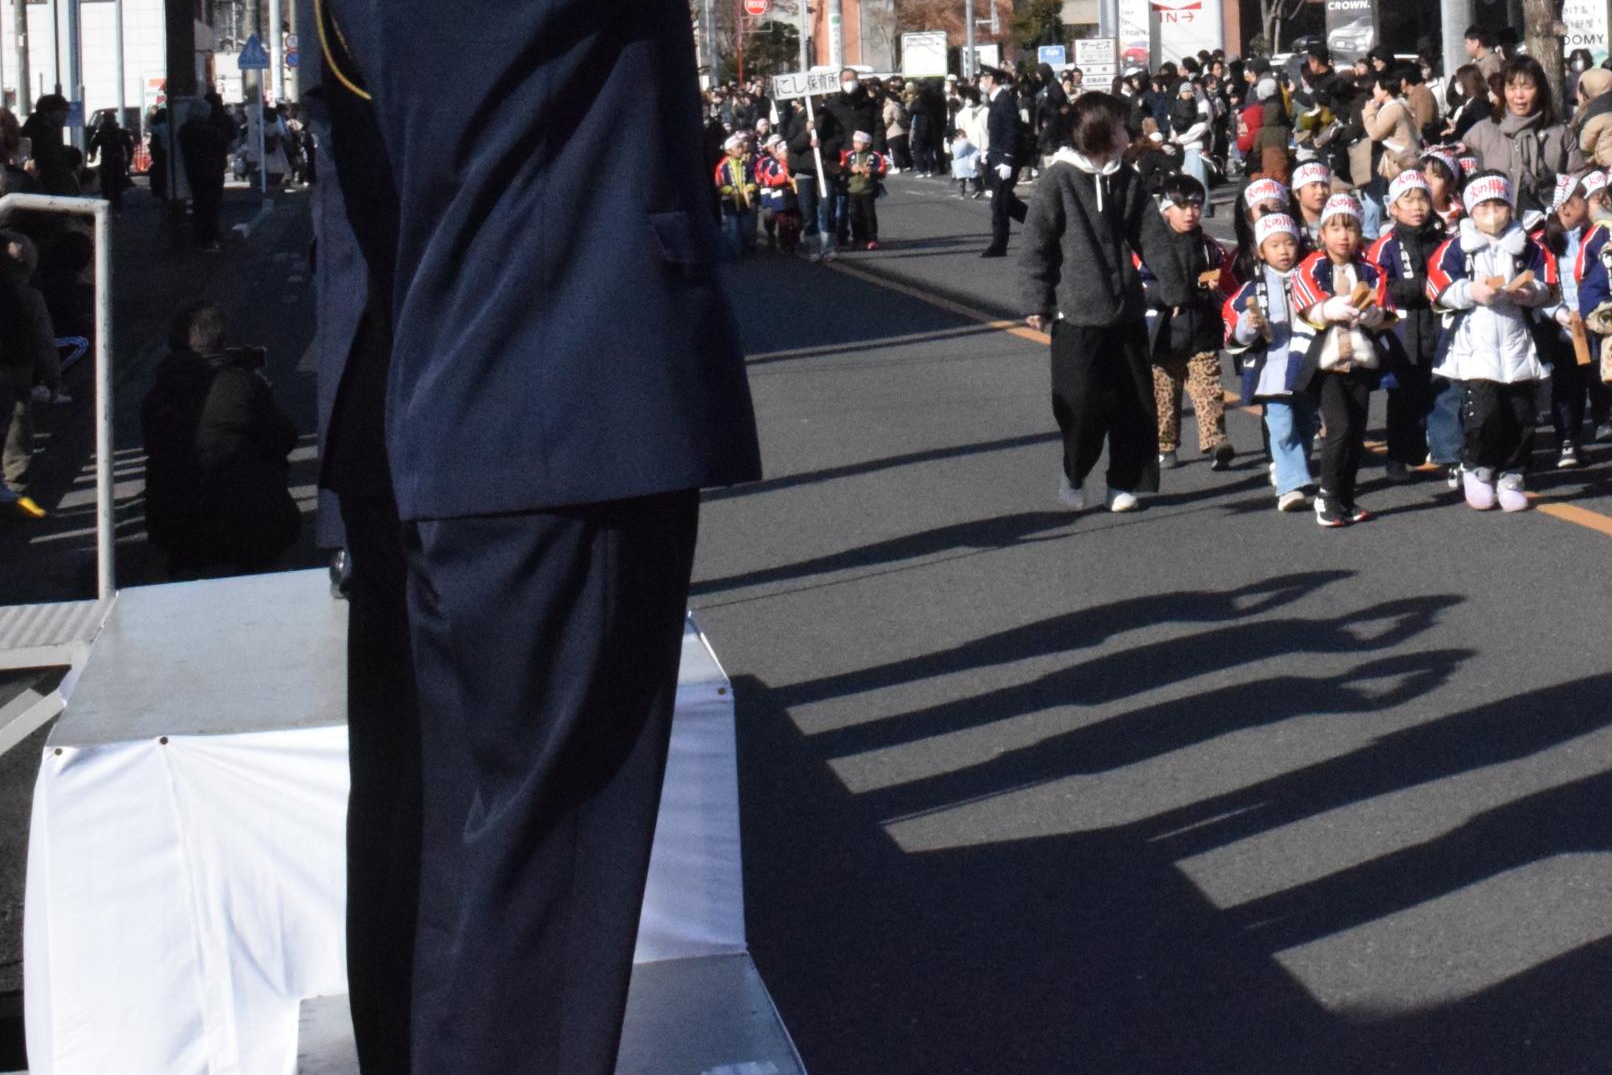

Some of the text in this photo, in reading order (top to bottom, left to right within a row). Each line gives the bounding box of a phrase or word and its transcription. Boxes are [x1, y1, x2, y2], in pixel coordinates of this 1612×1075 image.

[1327, 0, 1371, 11] CROWN.
[1563, 34, 1605, 46] OOMY
[775, 71, 839, 97] にし保育所
